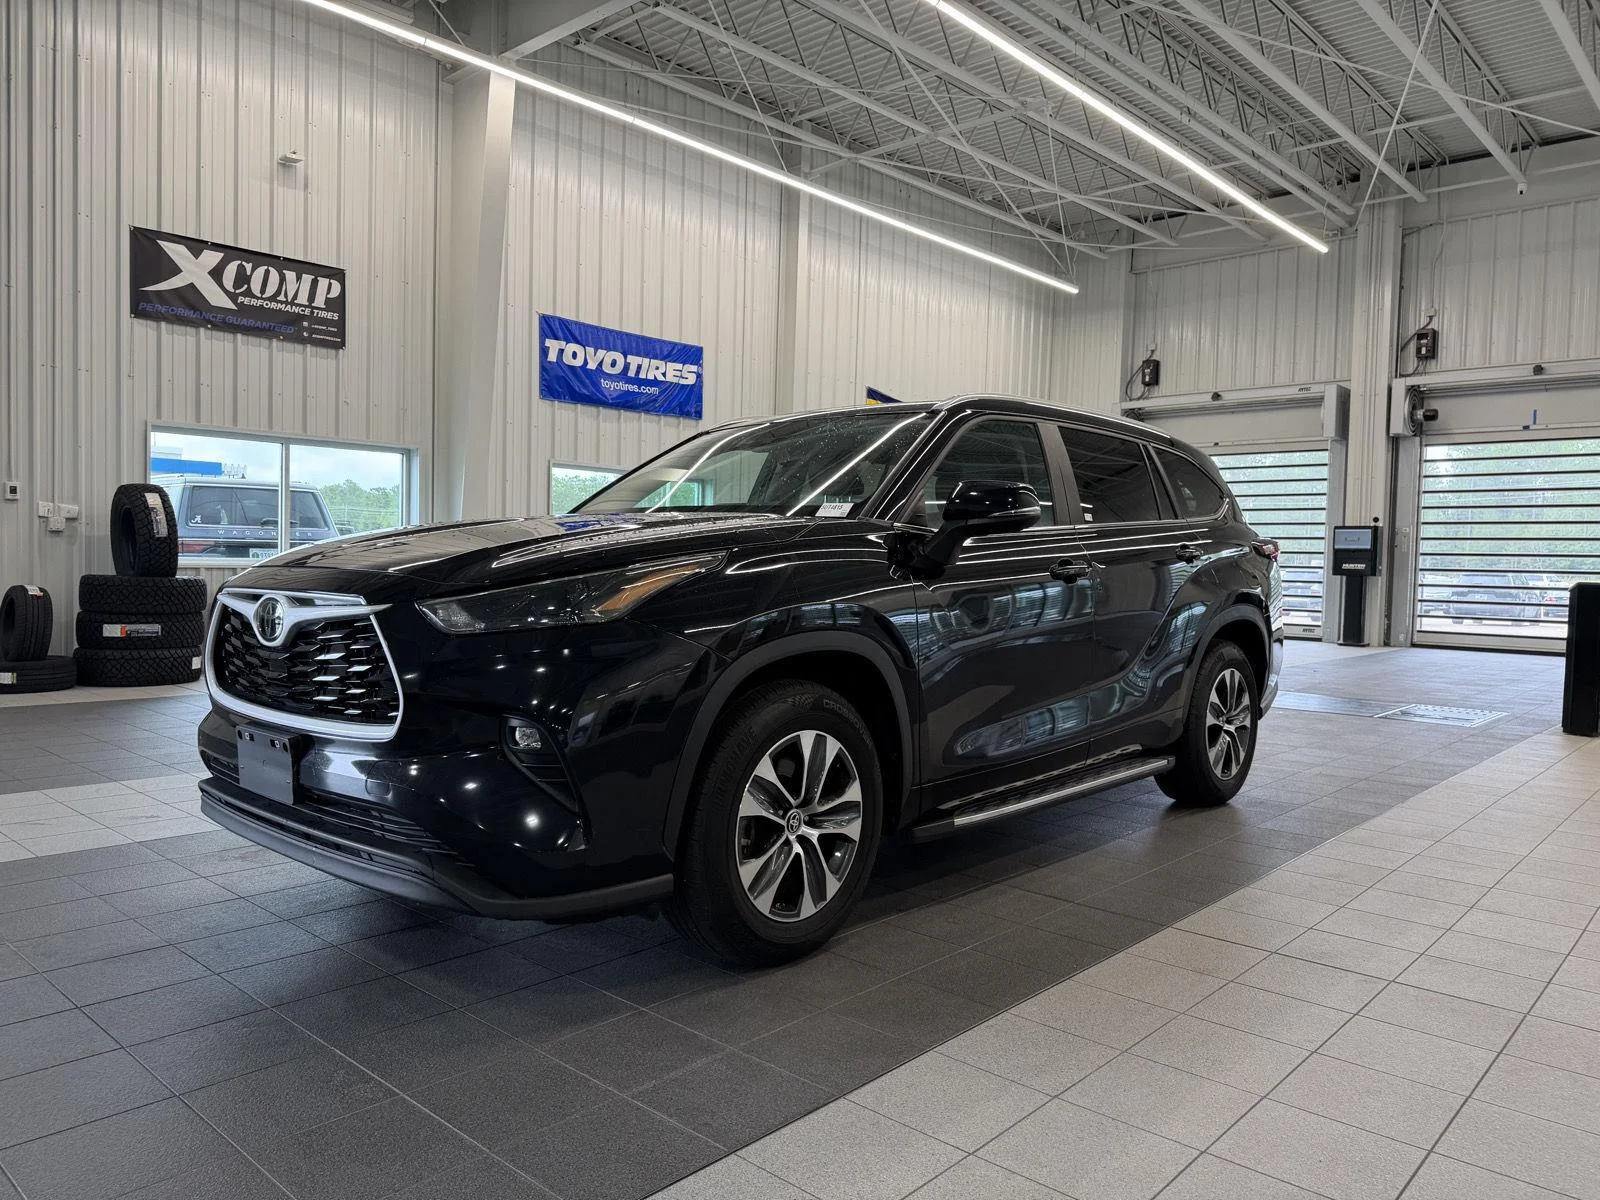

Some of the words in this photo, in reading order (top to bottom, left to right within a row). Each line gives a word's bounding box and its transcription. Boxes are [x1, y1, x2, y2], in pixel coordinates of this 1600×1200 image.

[138, 302, 225, 323] PERFORMANCE
[226, 315, 295, 334] GUARANTEED
[237, 296, 311, 316] PERFORMANCE
[313, 309, 340, 320] TIRES
[544, 338, 625, 375] TOYO
[626, 354, 698, 385] TIRES
[601, 377, 659, 395] toyotires.com
[218, 529, 312, 537] WAGONER
